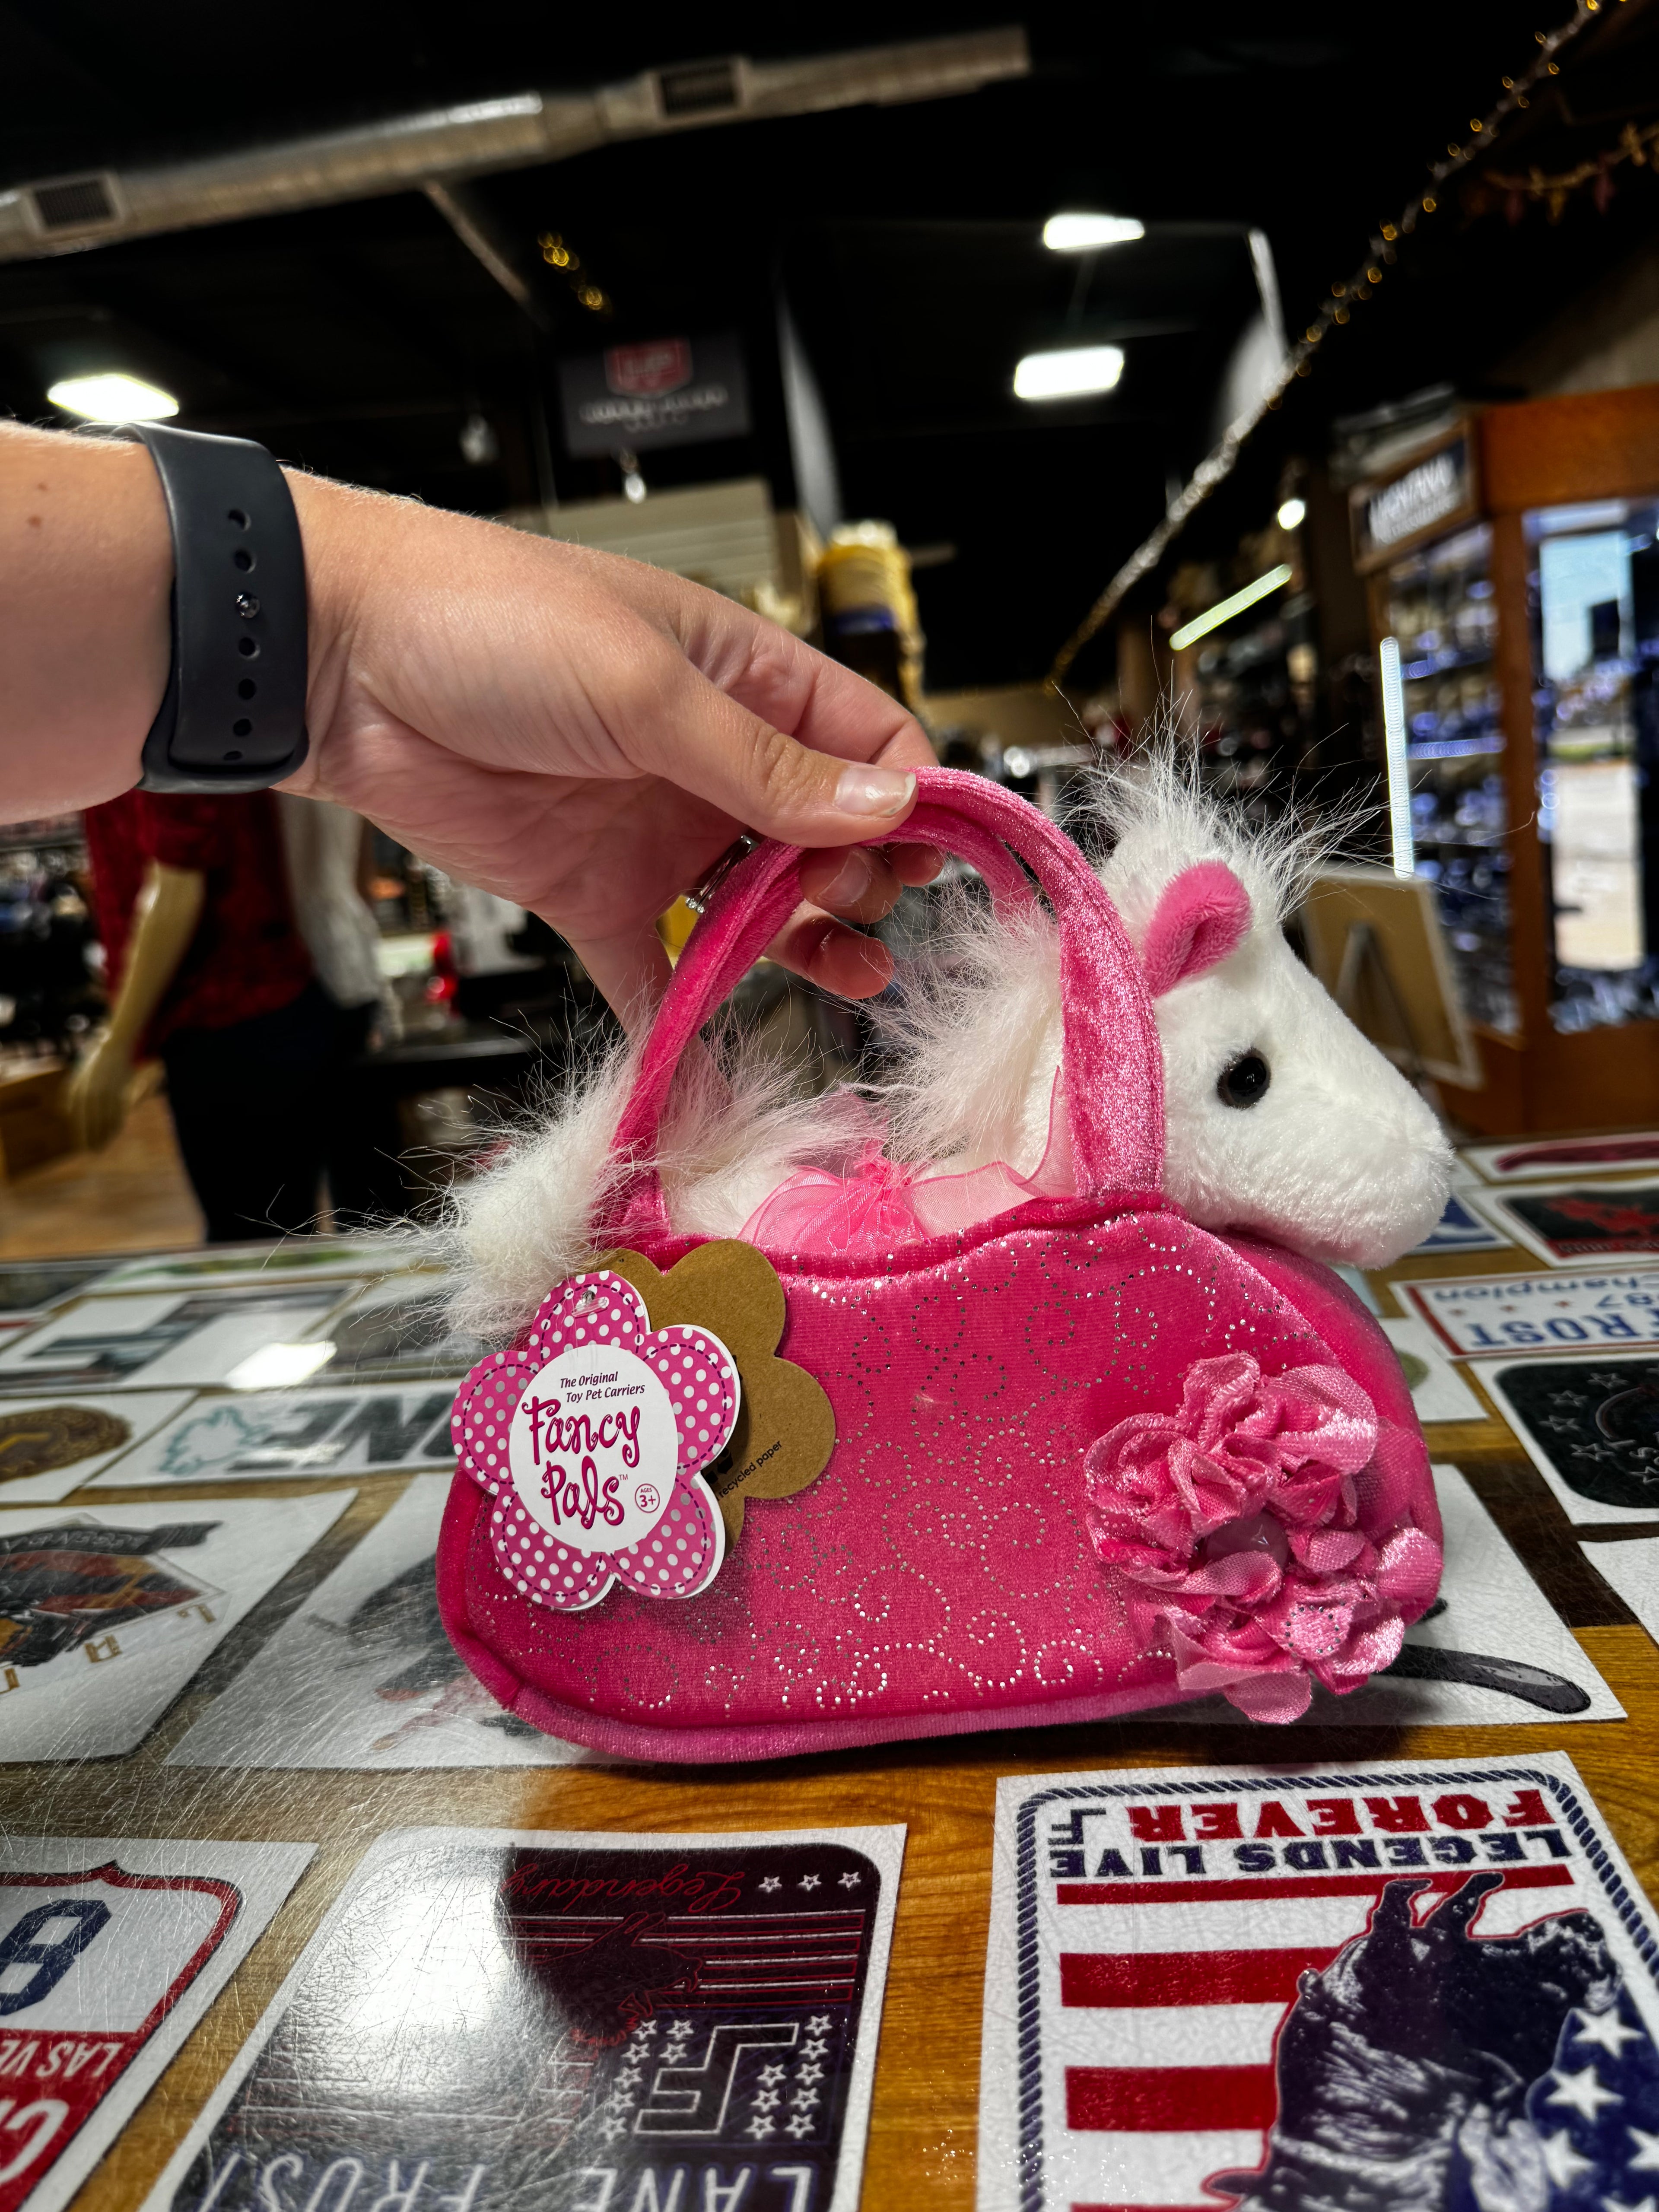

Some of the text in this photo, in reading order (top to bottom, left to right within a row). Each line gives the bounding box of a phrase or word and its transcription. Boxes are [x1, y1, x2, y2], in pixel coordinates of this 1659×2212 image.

[560, 1371, 618, 1388] The Original
[567, 1384, 645, 1403] Toy Pet Carriers
[521, 1396, 640, 1468] Fancy
[541, 1455, 625, 1529] Pals
[719, 1440, 782, 1499] recycled paper
[639, 1495, 656, 1507] 3+
[1125, 1789, 1556, 1842] FOREVER
[1049, 1828, 1572, 1877] LEGENDS LIVE
[500, 1863, 745, 1913] Legendary
[36, 2040, 124, 2077] LAS
